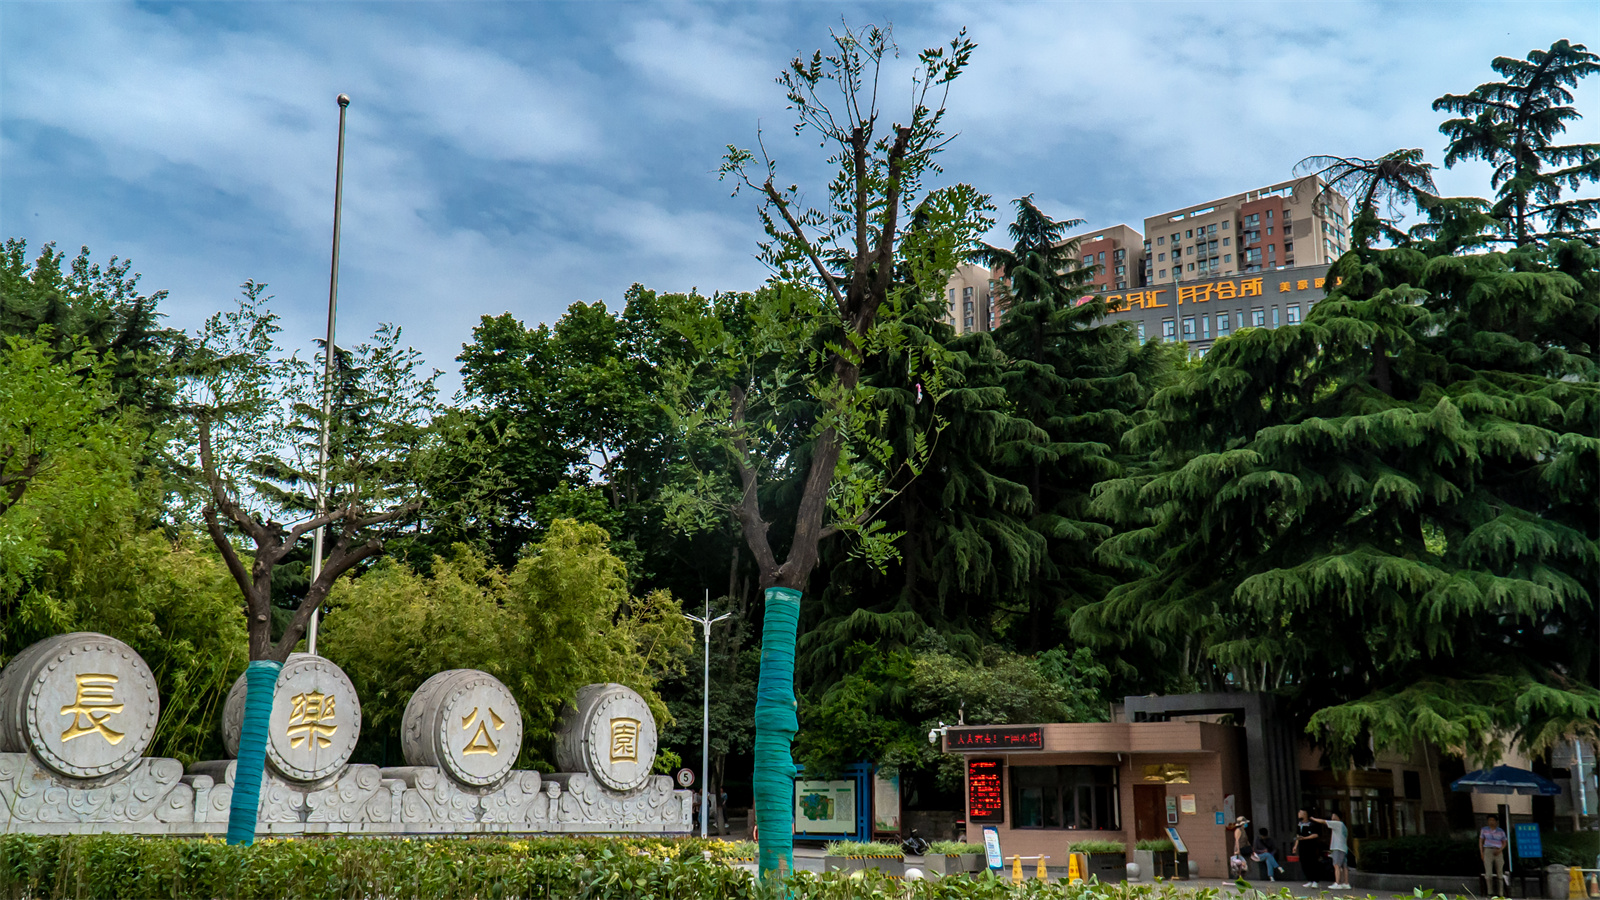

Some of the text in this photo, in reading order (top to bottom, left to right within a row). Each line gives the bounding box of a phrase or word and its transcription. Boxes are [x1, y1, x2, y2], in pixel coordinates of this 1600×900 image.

[60, 673, 642, 765] 長 樂 公 園
[683, 773, 689, 782] 5
